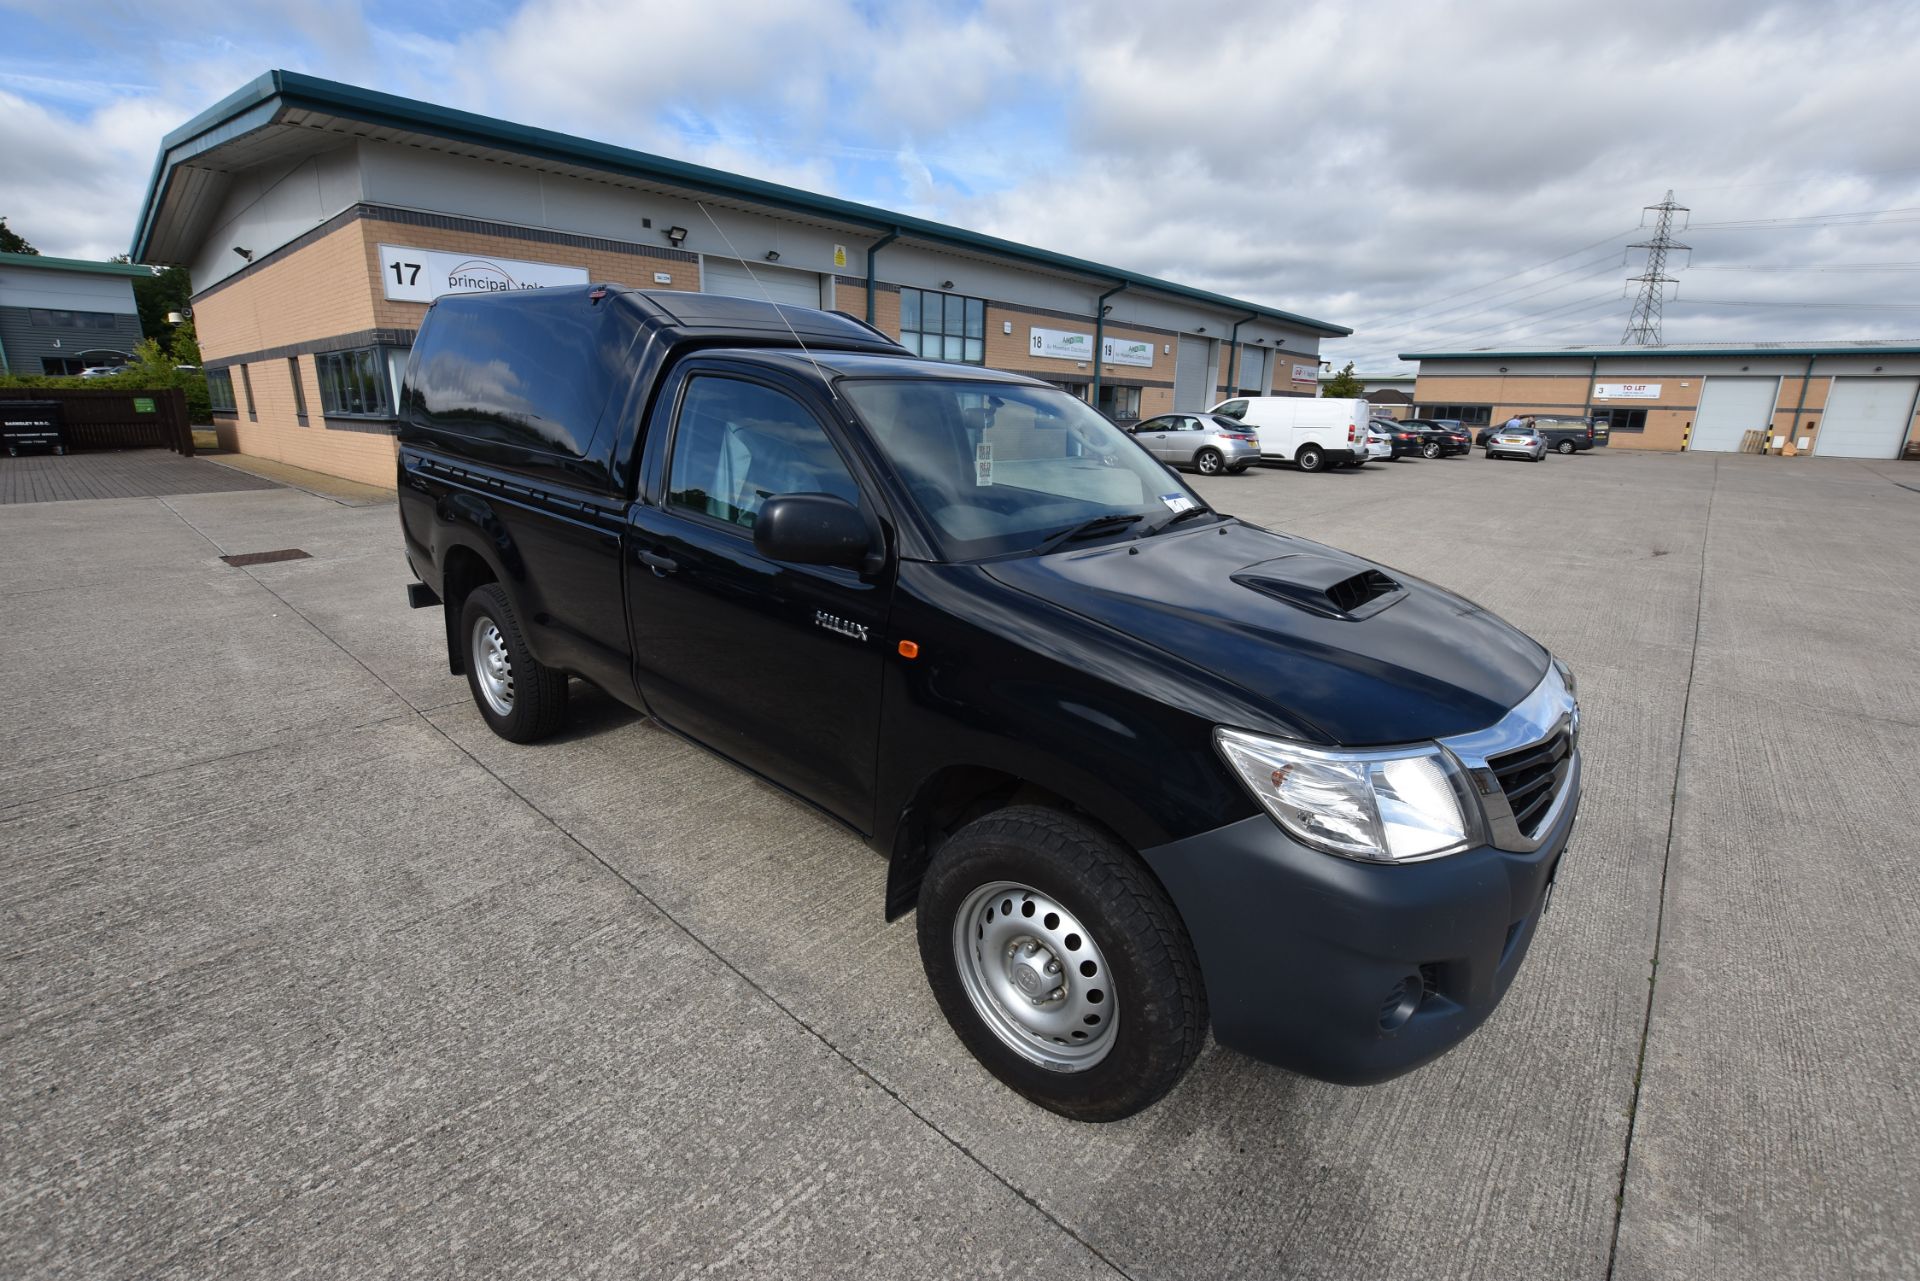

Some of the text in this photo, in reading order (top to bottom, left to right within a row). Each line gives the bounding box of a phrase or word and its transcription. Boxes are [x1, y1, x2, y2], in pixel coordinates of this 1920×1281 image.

[389, 261, 422, 286] 17
[448, 275, 510, 292] principal
[1032, 335, 1042, 349] 18
[1104, 344, 1112, 356] 19
[815, 606, 869, 641] HILUX
